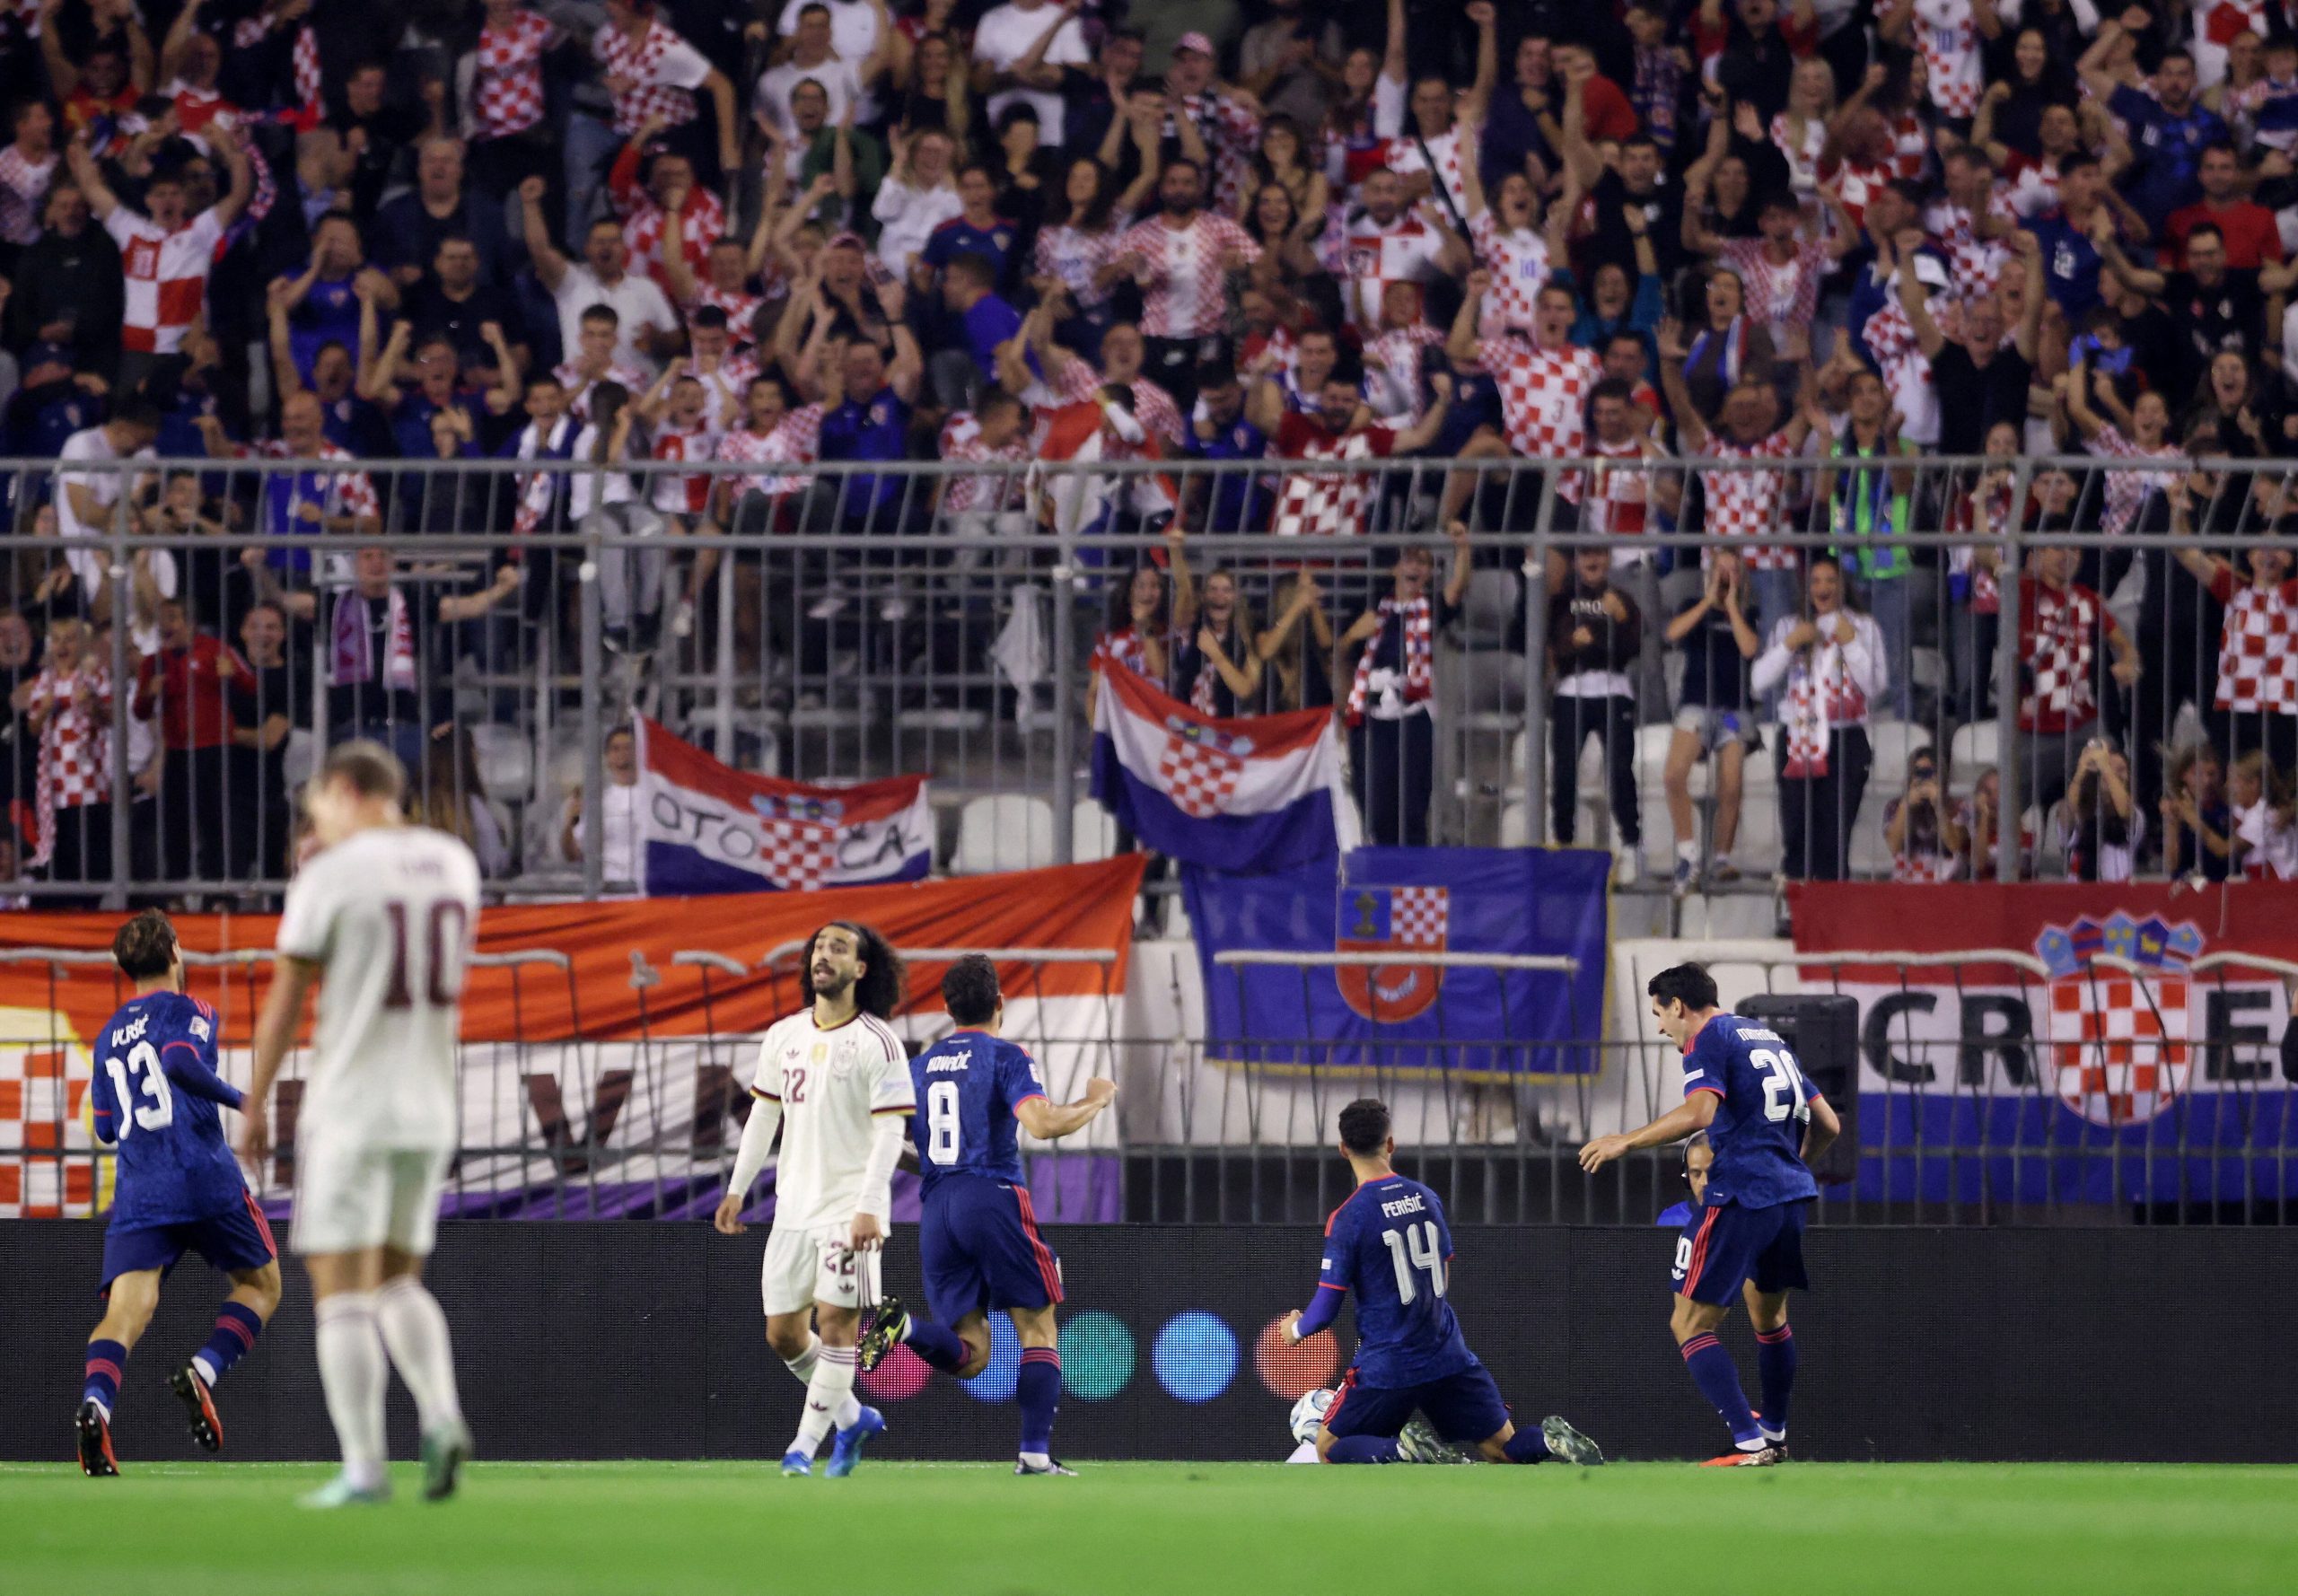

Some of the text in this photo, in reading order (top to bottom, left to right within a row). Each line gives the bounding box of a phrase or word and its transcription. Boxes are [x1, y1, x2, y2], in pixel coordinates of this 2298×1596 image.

[384, 899, 466, 1007] 10
[105, 1040, 172, 1140] 13
[782, 1068, 806, 1103] 22
[927, 1080, 960, 1165] 8
[1381, 1192, 1426, 1218] PERIŠIĆ
[1381, 1220, 1444, 1305] 14
[1675, 1235, 1693, 1270] 0
